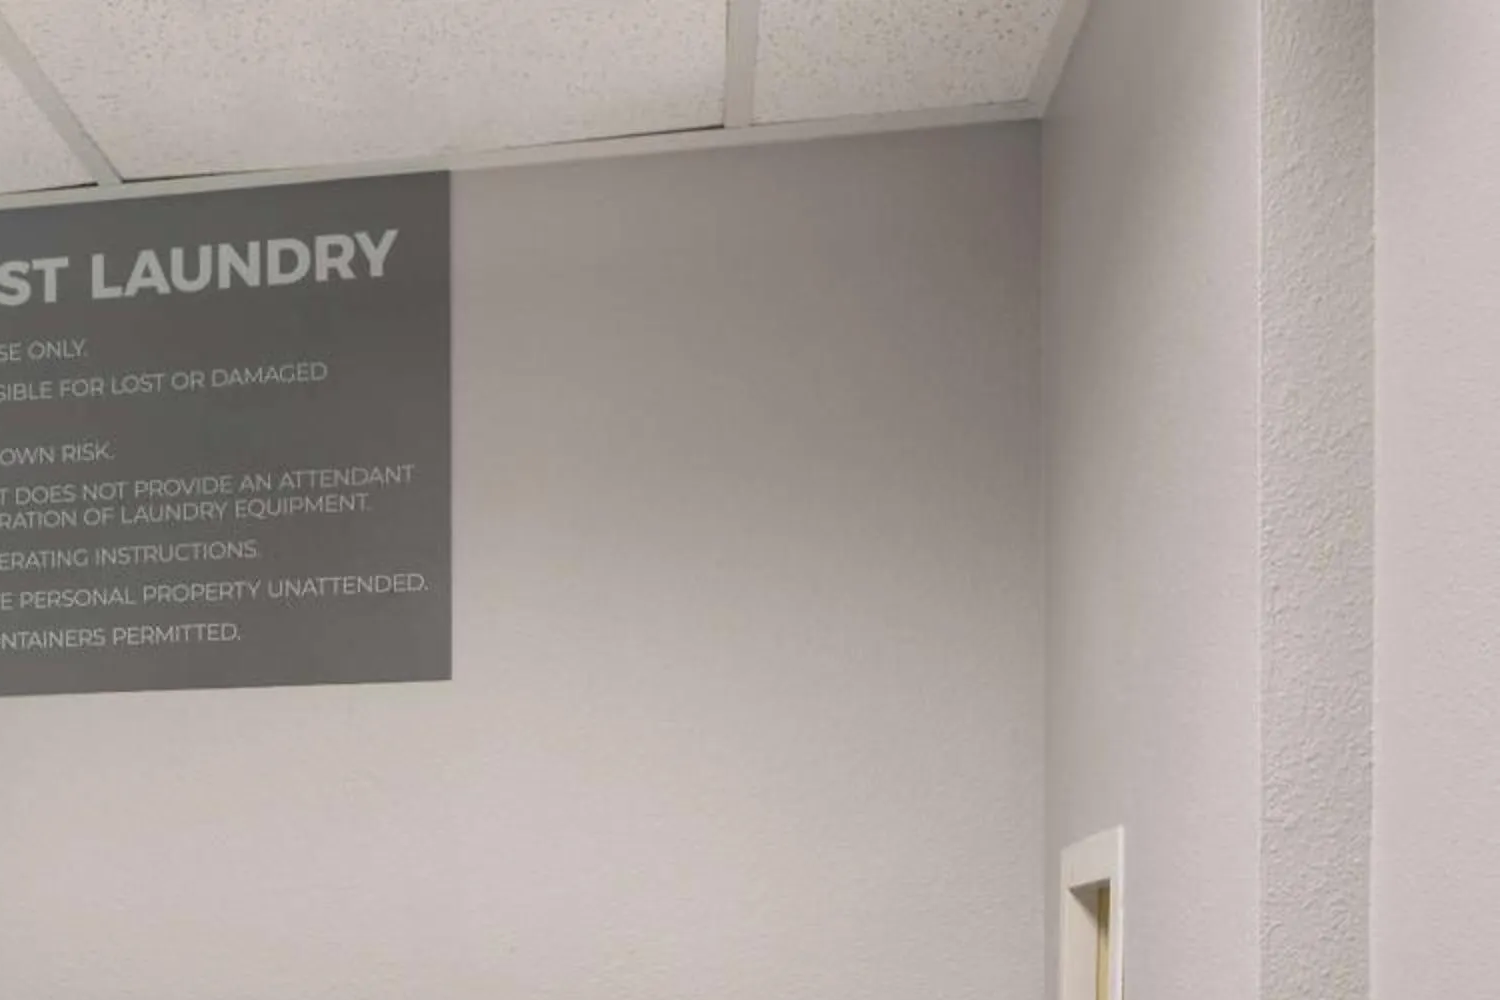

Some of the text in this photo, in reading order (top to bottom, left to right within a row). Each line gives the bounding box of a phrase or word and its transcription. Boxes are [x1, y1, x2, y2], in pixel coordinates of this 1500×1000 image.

[91, 230, 398, 298] LAUNDRY
[59, 377, 104, 397] FOR
[110, 373, 166, 395] LOST
[170, 371, 205, 390] OR
[211, 362, 327, 387] DAMAGED
[61, 442, 114, 463] RISK.
[15, 484, 77, 506] DOES
[81, 481, 128, 501] NOT
[133, 475, 232, 498] PROVIDE
[238, 472, 272, 492] AN
[277, 464, 414, 490] ATTENDANT
[82, 507, 114, 526] OF
[120, 501, 228, 524] LAUNDRY
[18, 587, 137, 609] PERSONAL
[142, 580, 261, 604] PROPERTY
[267, 573, 428, 600] UNATTENDED.
[111, 623, 240, 645] PERMITTED.
